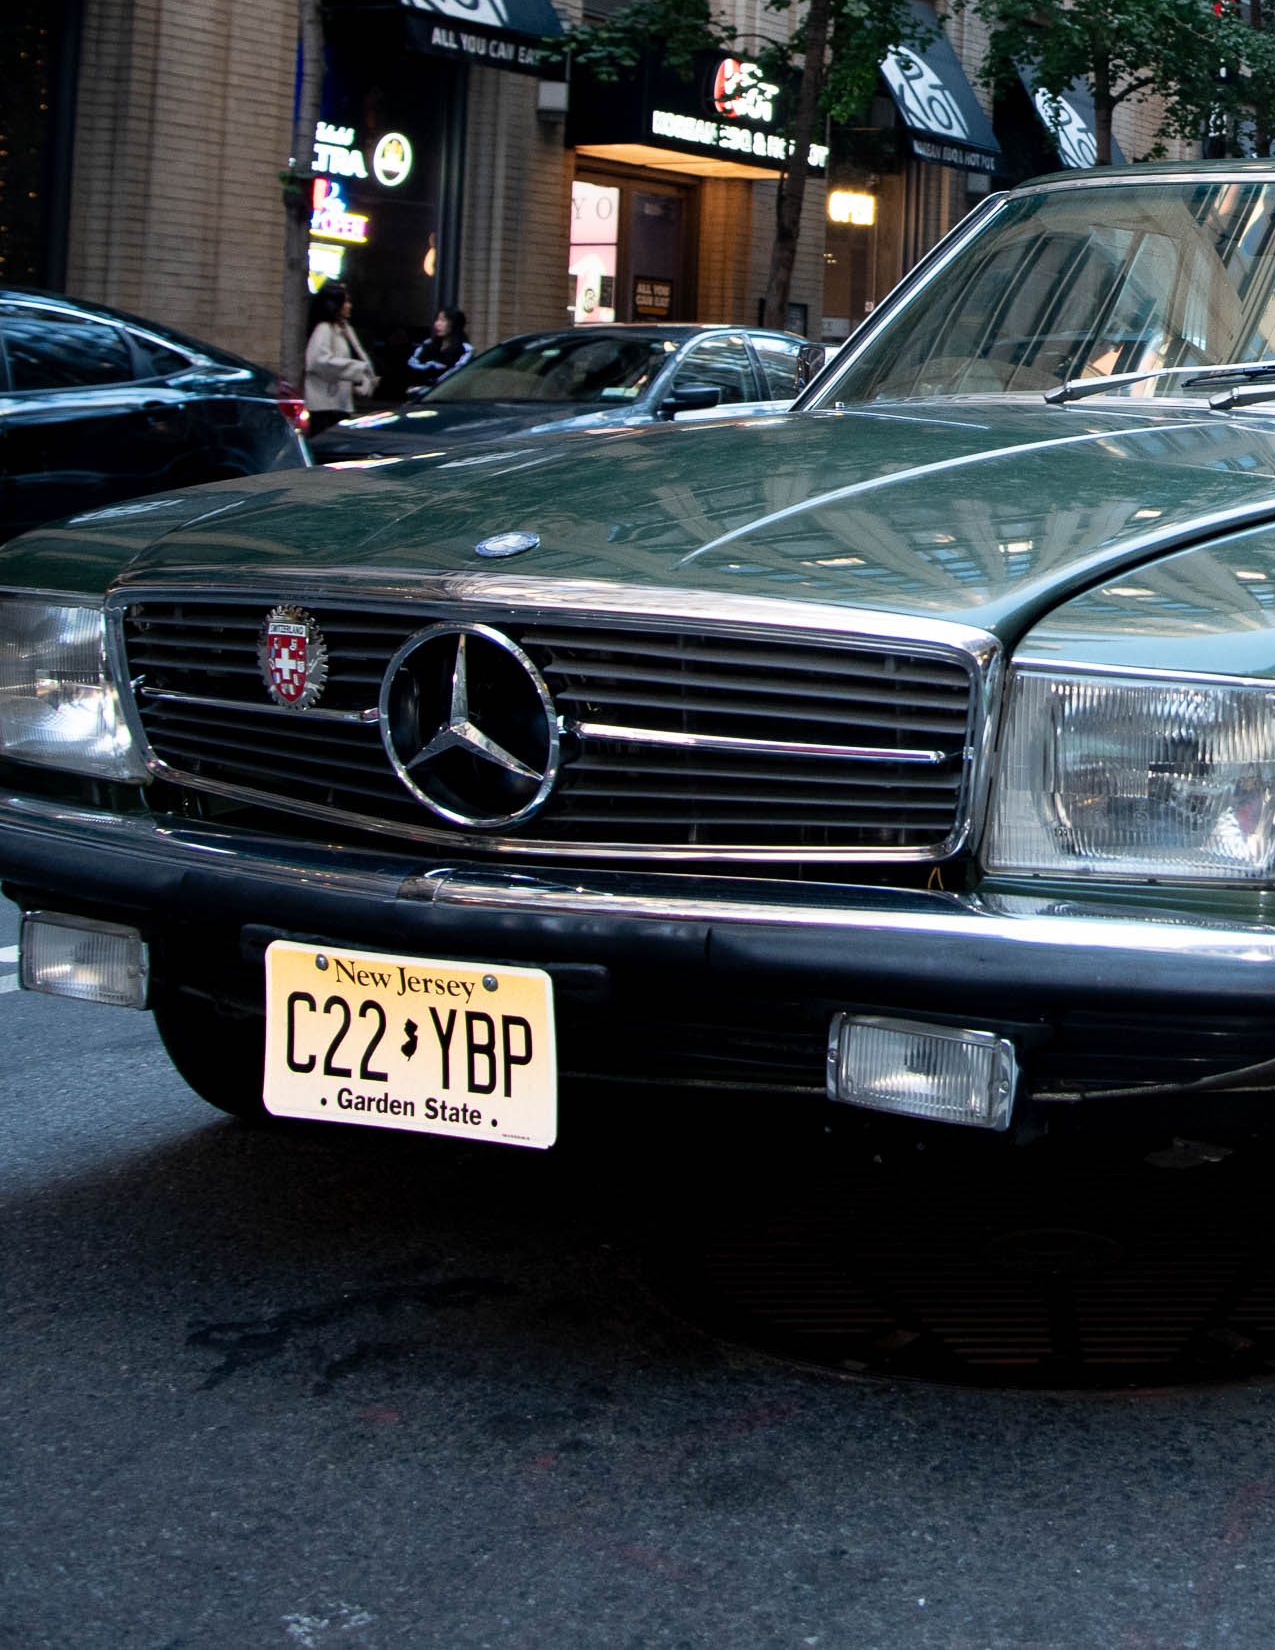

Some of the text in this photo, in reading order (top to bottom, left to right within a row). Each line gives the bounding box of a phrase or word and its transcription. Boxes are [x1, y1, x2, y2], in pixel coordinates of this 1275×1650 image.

[431, 26, 540, 67] ALL YOU CAN EA
[334, 957, 477, 1004] New Jersey
[286, 991, 533, 1098] C22 YBP
[336, 1087, 482, 1126] Garden State
